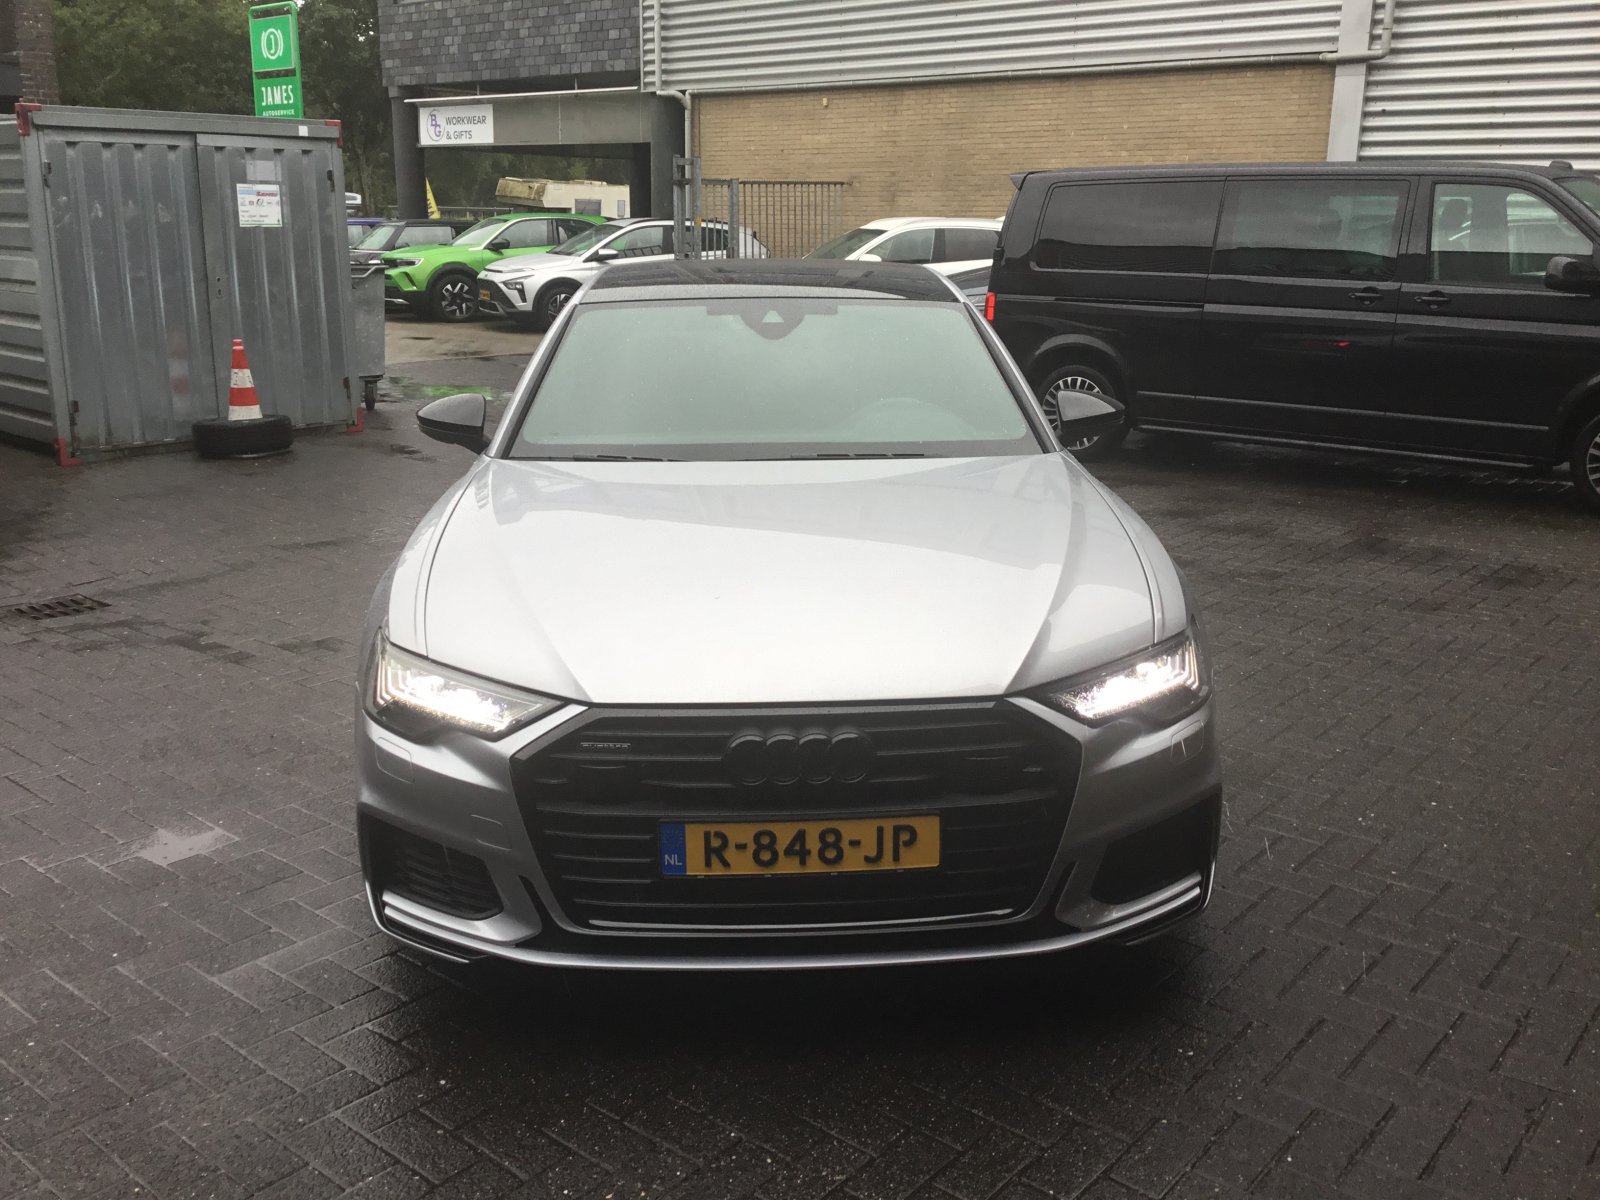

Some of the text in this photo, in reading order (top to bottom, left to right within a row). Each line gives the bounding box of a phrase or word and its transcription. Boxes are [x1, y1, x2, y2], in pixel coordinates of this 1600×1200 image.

[261, 85, 294, 106] JAMES
[445, 115, 487, 126] WORKWEAR
[445, 130, 473, 140] & GIFTS
[703, 824, 919, 868] R-848-JP
[664, 854, 682, 866] NL
